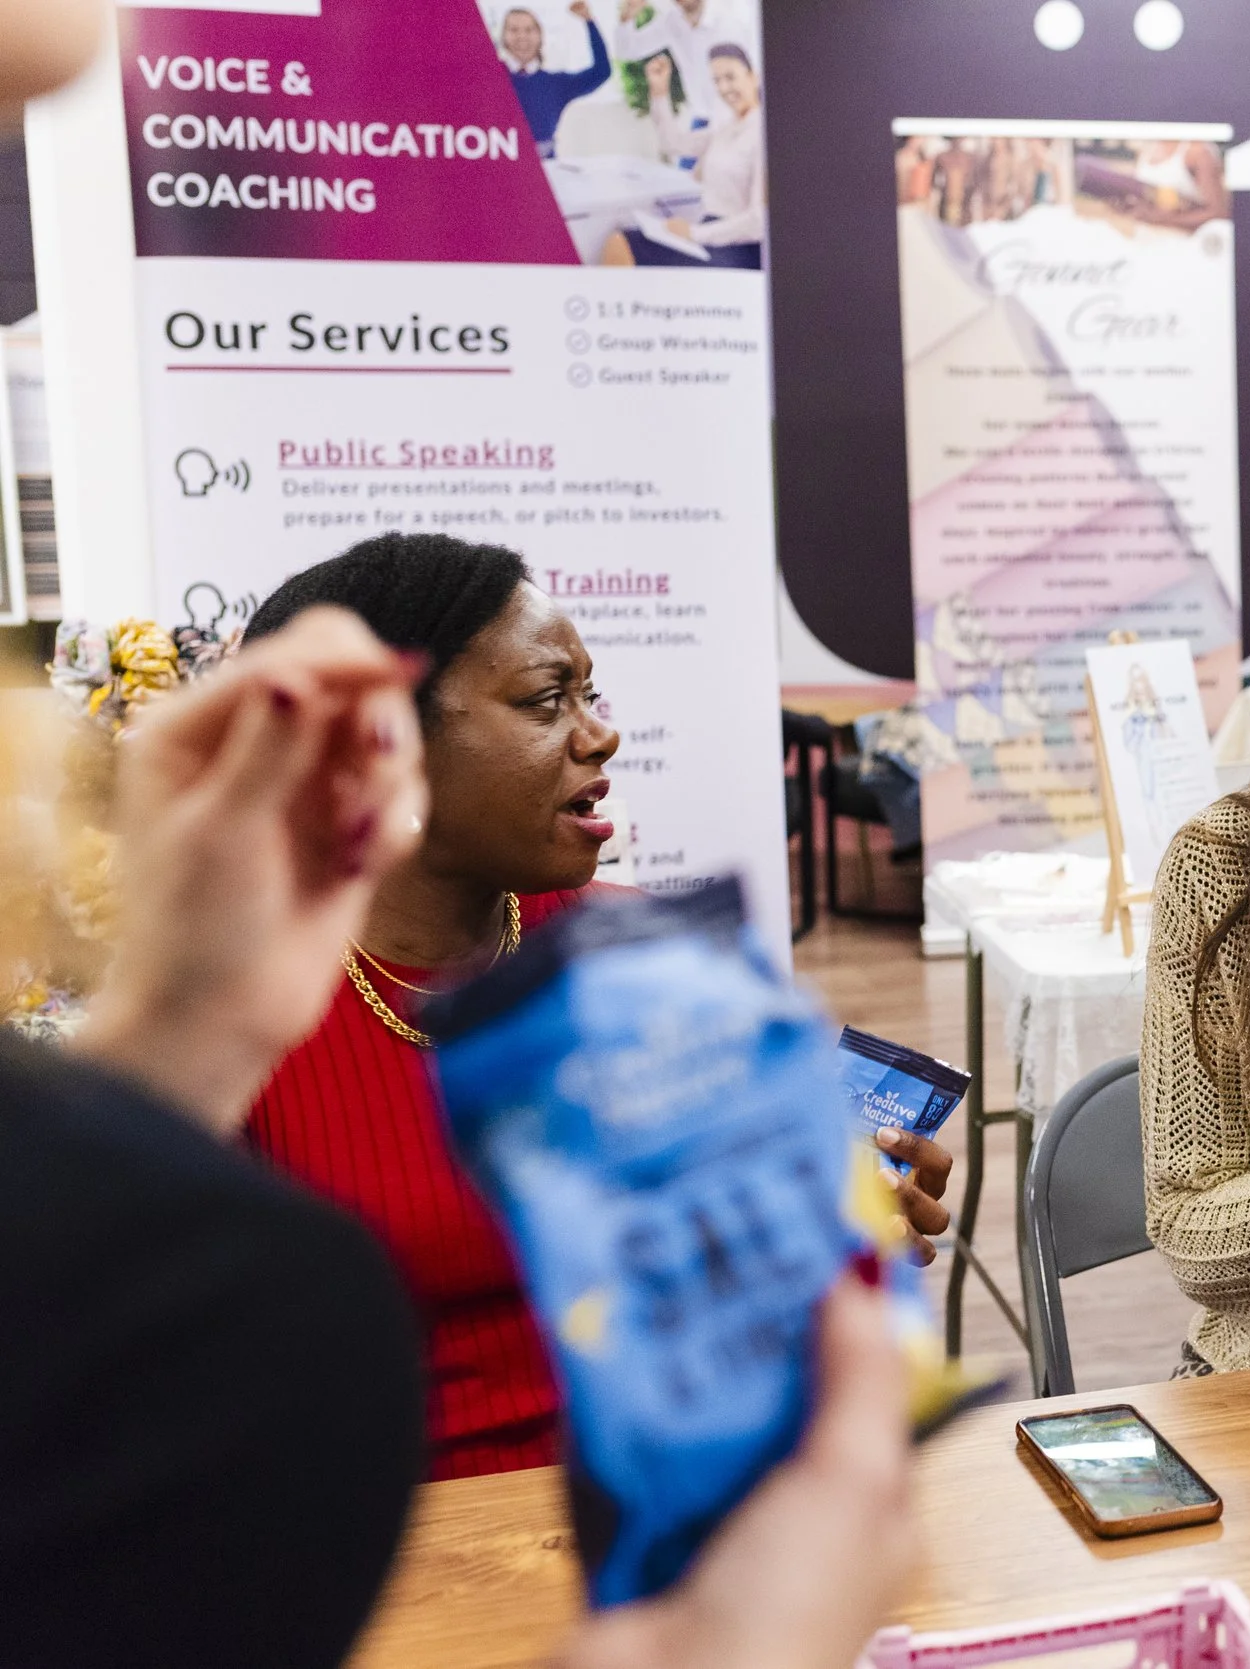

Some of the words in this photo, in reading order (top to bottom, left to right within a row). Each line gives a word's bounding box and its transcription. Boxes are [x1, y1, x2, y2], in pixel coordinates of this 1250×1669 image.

[136, 54, 271, 94] VOICE
[280, 60, 313, 97] &
[142, 113, 520, 161] COMMUNICATION
[146, 171, 377, 214] COACHING
[630, 301, 742, 321] Programmes
[165, 311, 268, 352] Our
[288, 312, 511, 353] Services
[598, 333, 655, 352] Group
[660, 335, 758, 354] Workshops
[599, 367, 653, 385] Guest
[659, 367, 730, 387] Speaker
[278, 438, 386, 467] Public
[399, 438, 555, 471] Speaking
[282, 478, 358, 496] Deliver
[367, 479, 511, 499] presentations
[520, 478, 556, 495] and
[283, 511, 367, 528] prepare
[374, 508, 403, 525] for
[414, 512, 423, 524] a
[515, 510, 536, 523] or
[544, 507, 595, 527] pitch
[602, 508, 623, 523] to
[546, 568, 670, 598] Training
[564, 601, 650, 621] rkplace,
[655, 602, 707, 618] learn
[607, 757, 671, 776] nergy.
[649, 848, 684, 867] and
[863, 1088, 917, 1121] Creative
[932, 1094, 950, 1108] ONLY
[860, 1103, 904, 1128] Nature
